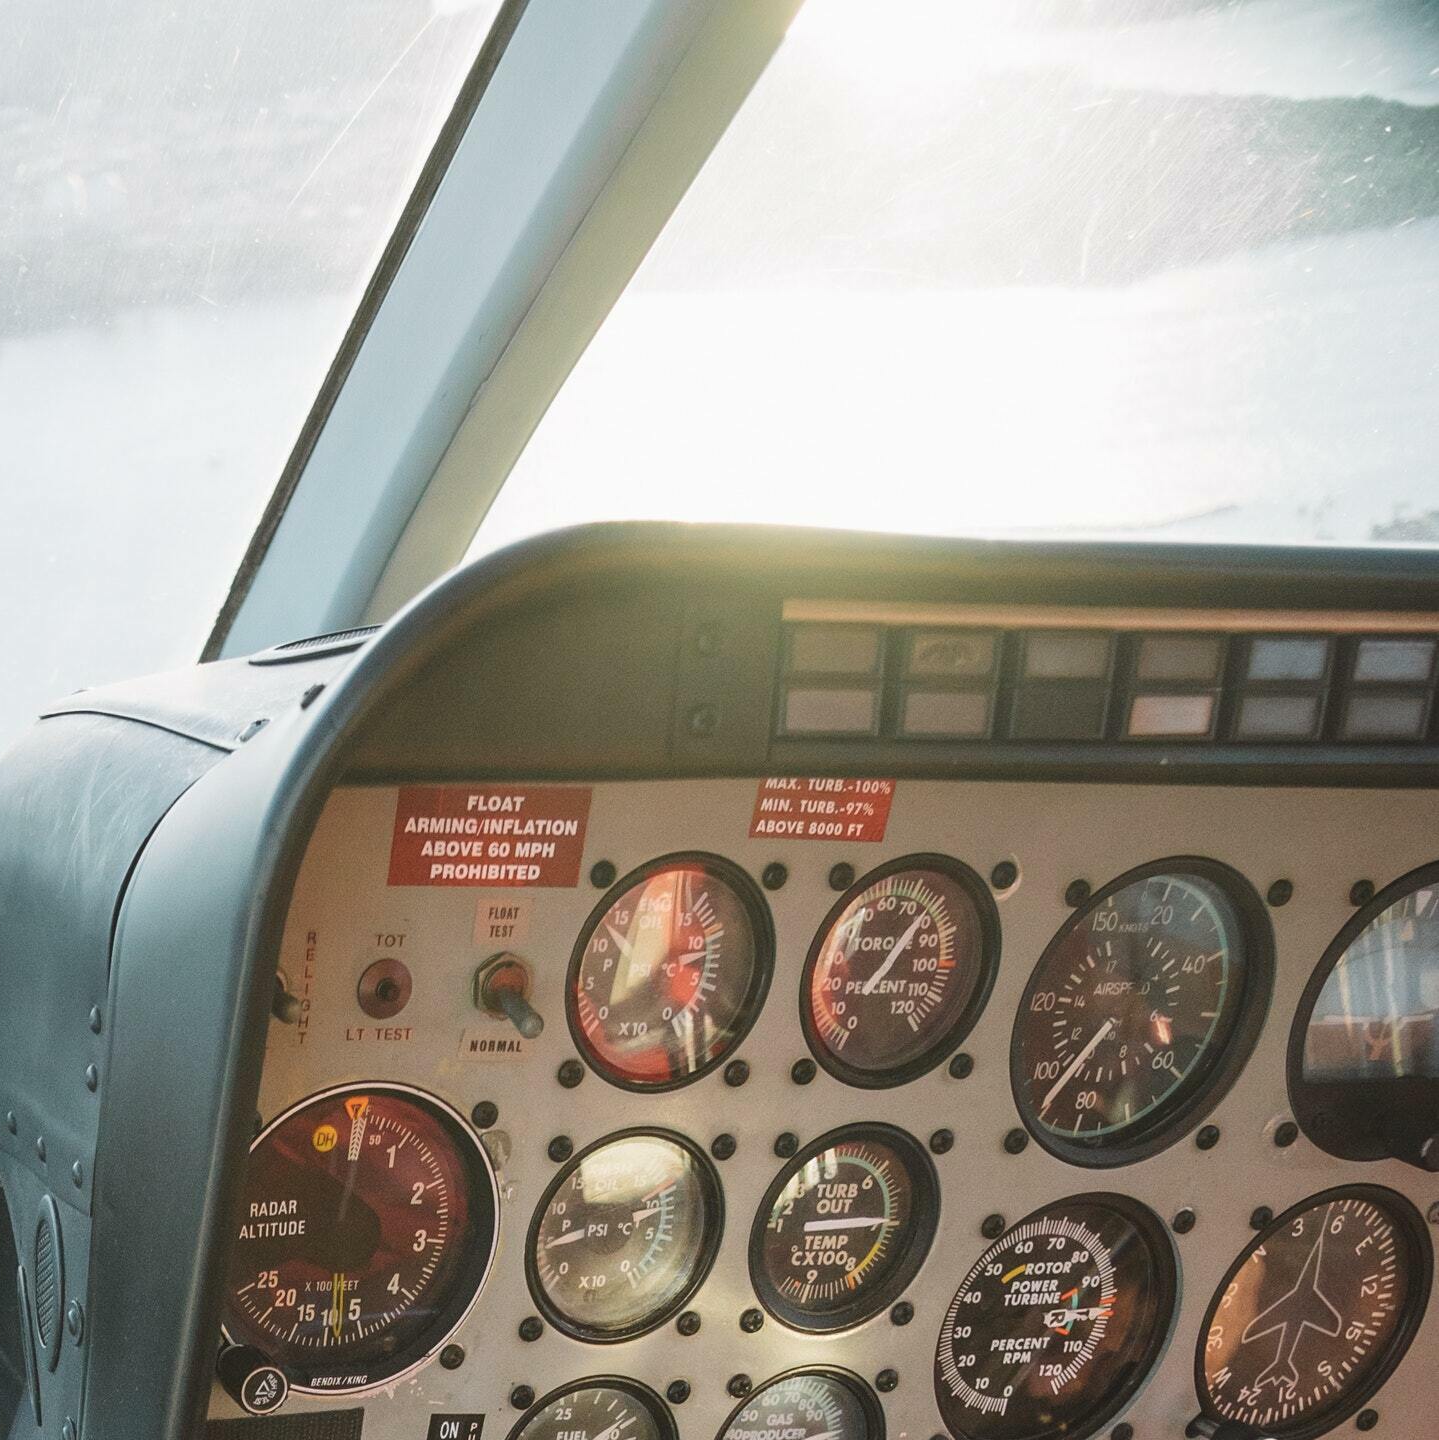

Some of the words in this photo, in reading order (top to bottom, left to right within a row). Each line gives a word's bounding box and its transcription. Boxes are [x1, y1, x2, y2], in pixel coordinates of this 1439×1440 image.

[765, 778, 801, 791] MAX.
[467, 795, 525, 812] FLOAT
[761, 798, 793, 813] MIN.
[800, 800, 874, 816] TURB.-97%
[405, 817, 578, 836] ARMING/INFLATION
[756, 820, 804, 834] ABOVE
[809, 822, 843, 836] 8000
[848, 824, 864, 837] FT
[421, 841, 483, 857] ABOVE
[488, 842, 509, 858] 60
[515, 843, 555, 858] MPH
[430, 864, 540, 880] PROHIBITED
[489, 907, 520, 920] FLOAT
[490, 925, 514, 938] TEST
[376, 934, 406, 947] TOT
[853, 937, 912, 950] TORQE
[912, 958, 936, 971] 100
[298, 932, 317, 1044] RELIGHT
[846, 980, 906, 994] PECENT
[891, 1001, 914, 1014] 120
[1030, 992, 1055, 1011] 120
[346, 1029, 365, 1041] LT
[375, 1028, 412, 1040] TEST
[469, 1040, 522, 1052] NORMAL
[1034, 1062, 1059, 1080] 100
[1075, 1091, 1097, 1109] 80
[316, 1132, 334, 1146] DH
[817, 1184, 858, 1197] TURB
[250, 1200, 297, 1218] RADAR
[817, 1200, 853, 1214] OUT
[239, 1220, 306, 1240] ALTITUDE
[588, 1224, 608, 1237] PSI
[805, 1236, 848, 1250] TEMP
[985, 1263, 1002, 1276] 50
[1025, 1261, 1072, 1275] ROTOR
[257, 1271, 278, 1288] 25
[1011, 1280, 1058, 1292] POWER
[275, 1288, 296, 1307] 20
[964, 1292, 981, 1303] 40
[1004, 1292, 1060, 1306] TURBINE
[348, 1298, 361, 1321] 5
[991, 1337, 1050, 1351] PERCENT
[1002, 1351, 1030, 1364] RPM
[1039, 1364, 1062, 1376] 120
[311, 1375, 367, 1387] BENDIX/KING
[767, 1413, 794, 1426] GAS
[440, 1421, 460, 1439] ON
